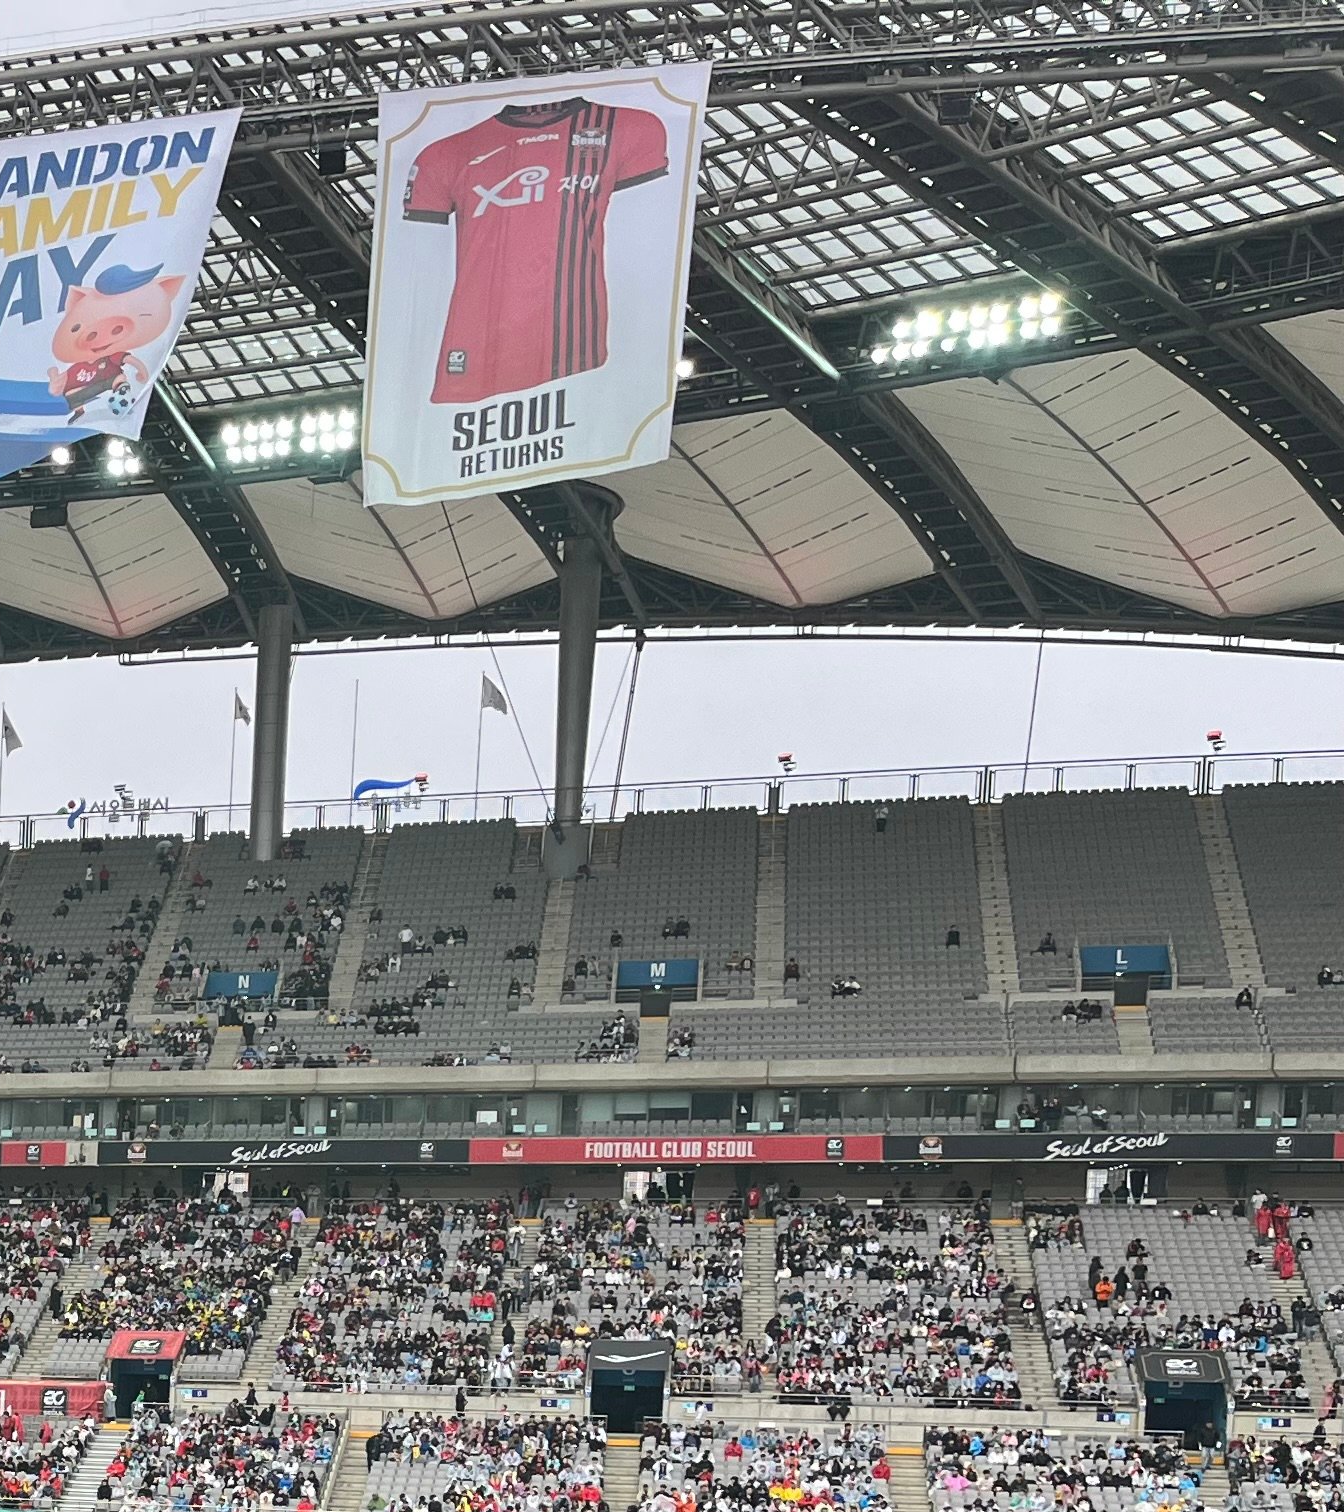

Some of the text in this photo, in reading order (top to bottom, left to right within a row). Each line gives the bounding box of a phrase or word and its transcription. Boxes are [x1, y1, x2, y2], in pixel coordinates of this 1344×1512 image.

[516, 133, 559, 146] TMON
[558, 174, 601, 194] 자이
[451, 389, 576, 451] SEOUL
[460, 436, 564, 479] RETURNS
[282, 1140, 331, 1156] Seoul
[585, 1141, 756, 1158] FOOTBALL CLUB SEOUL
[1108, 1132, 1168, 1153] Seoul
